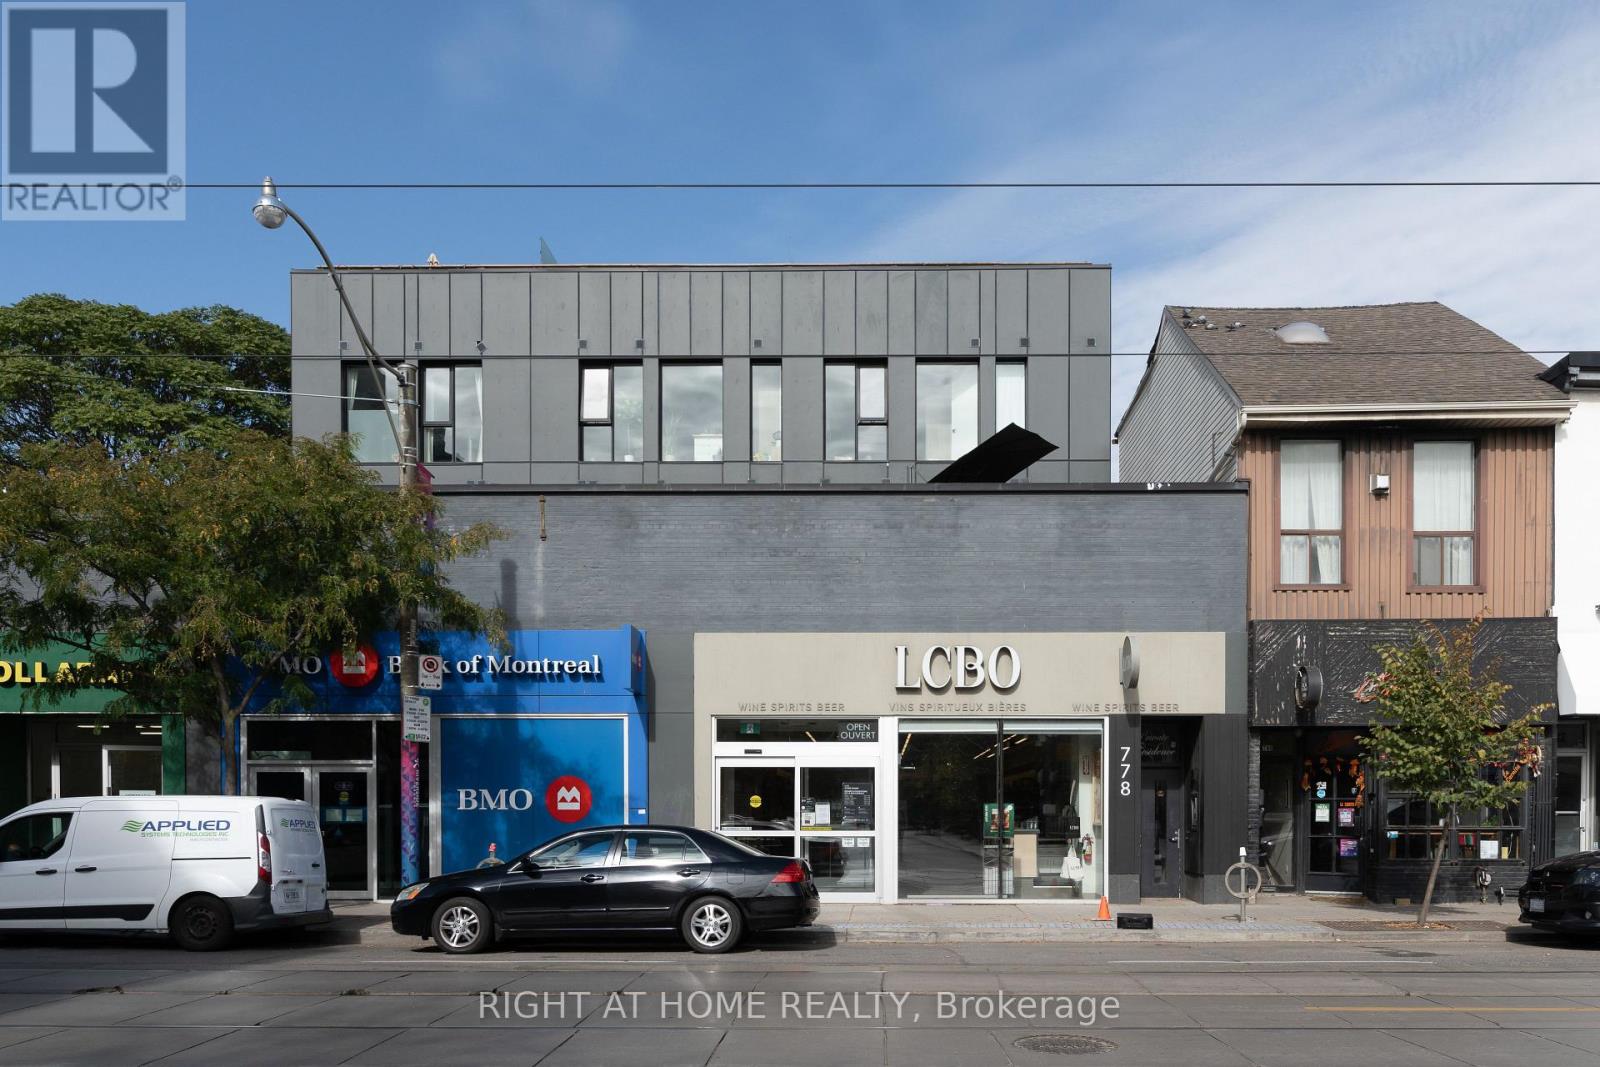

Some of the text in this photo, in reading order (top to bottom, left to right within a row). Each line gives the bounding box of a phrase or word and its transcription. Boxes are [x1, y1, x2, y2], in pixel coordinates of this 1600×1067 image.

[456, 654, 483, 674] of
[487, 654, 601, 674] Montreal
[895, 645, 1022, 689] LCBO
[738, 703, 845, 712] WINE SPIRITS BEER
[888, 703, 914, 712] VINS
[919, 703, 984, 712] SPIRITUEUX
[1072, 703, 1180, 712] WINE SPIRITS BEER
[846, 723, 871, 731] OPEN
[840, 731, 876, 740] OUVERT
[1120, 746, 1131, 796] 778
[456, 788, 533, 811] BMO
[141, 820, 231, 832] APPLIED
